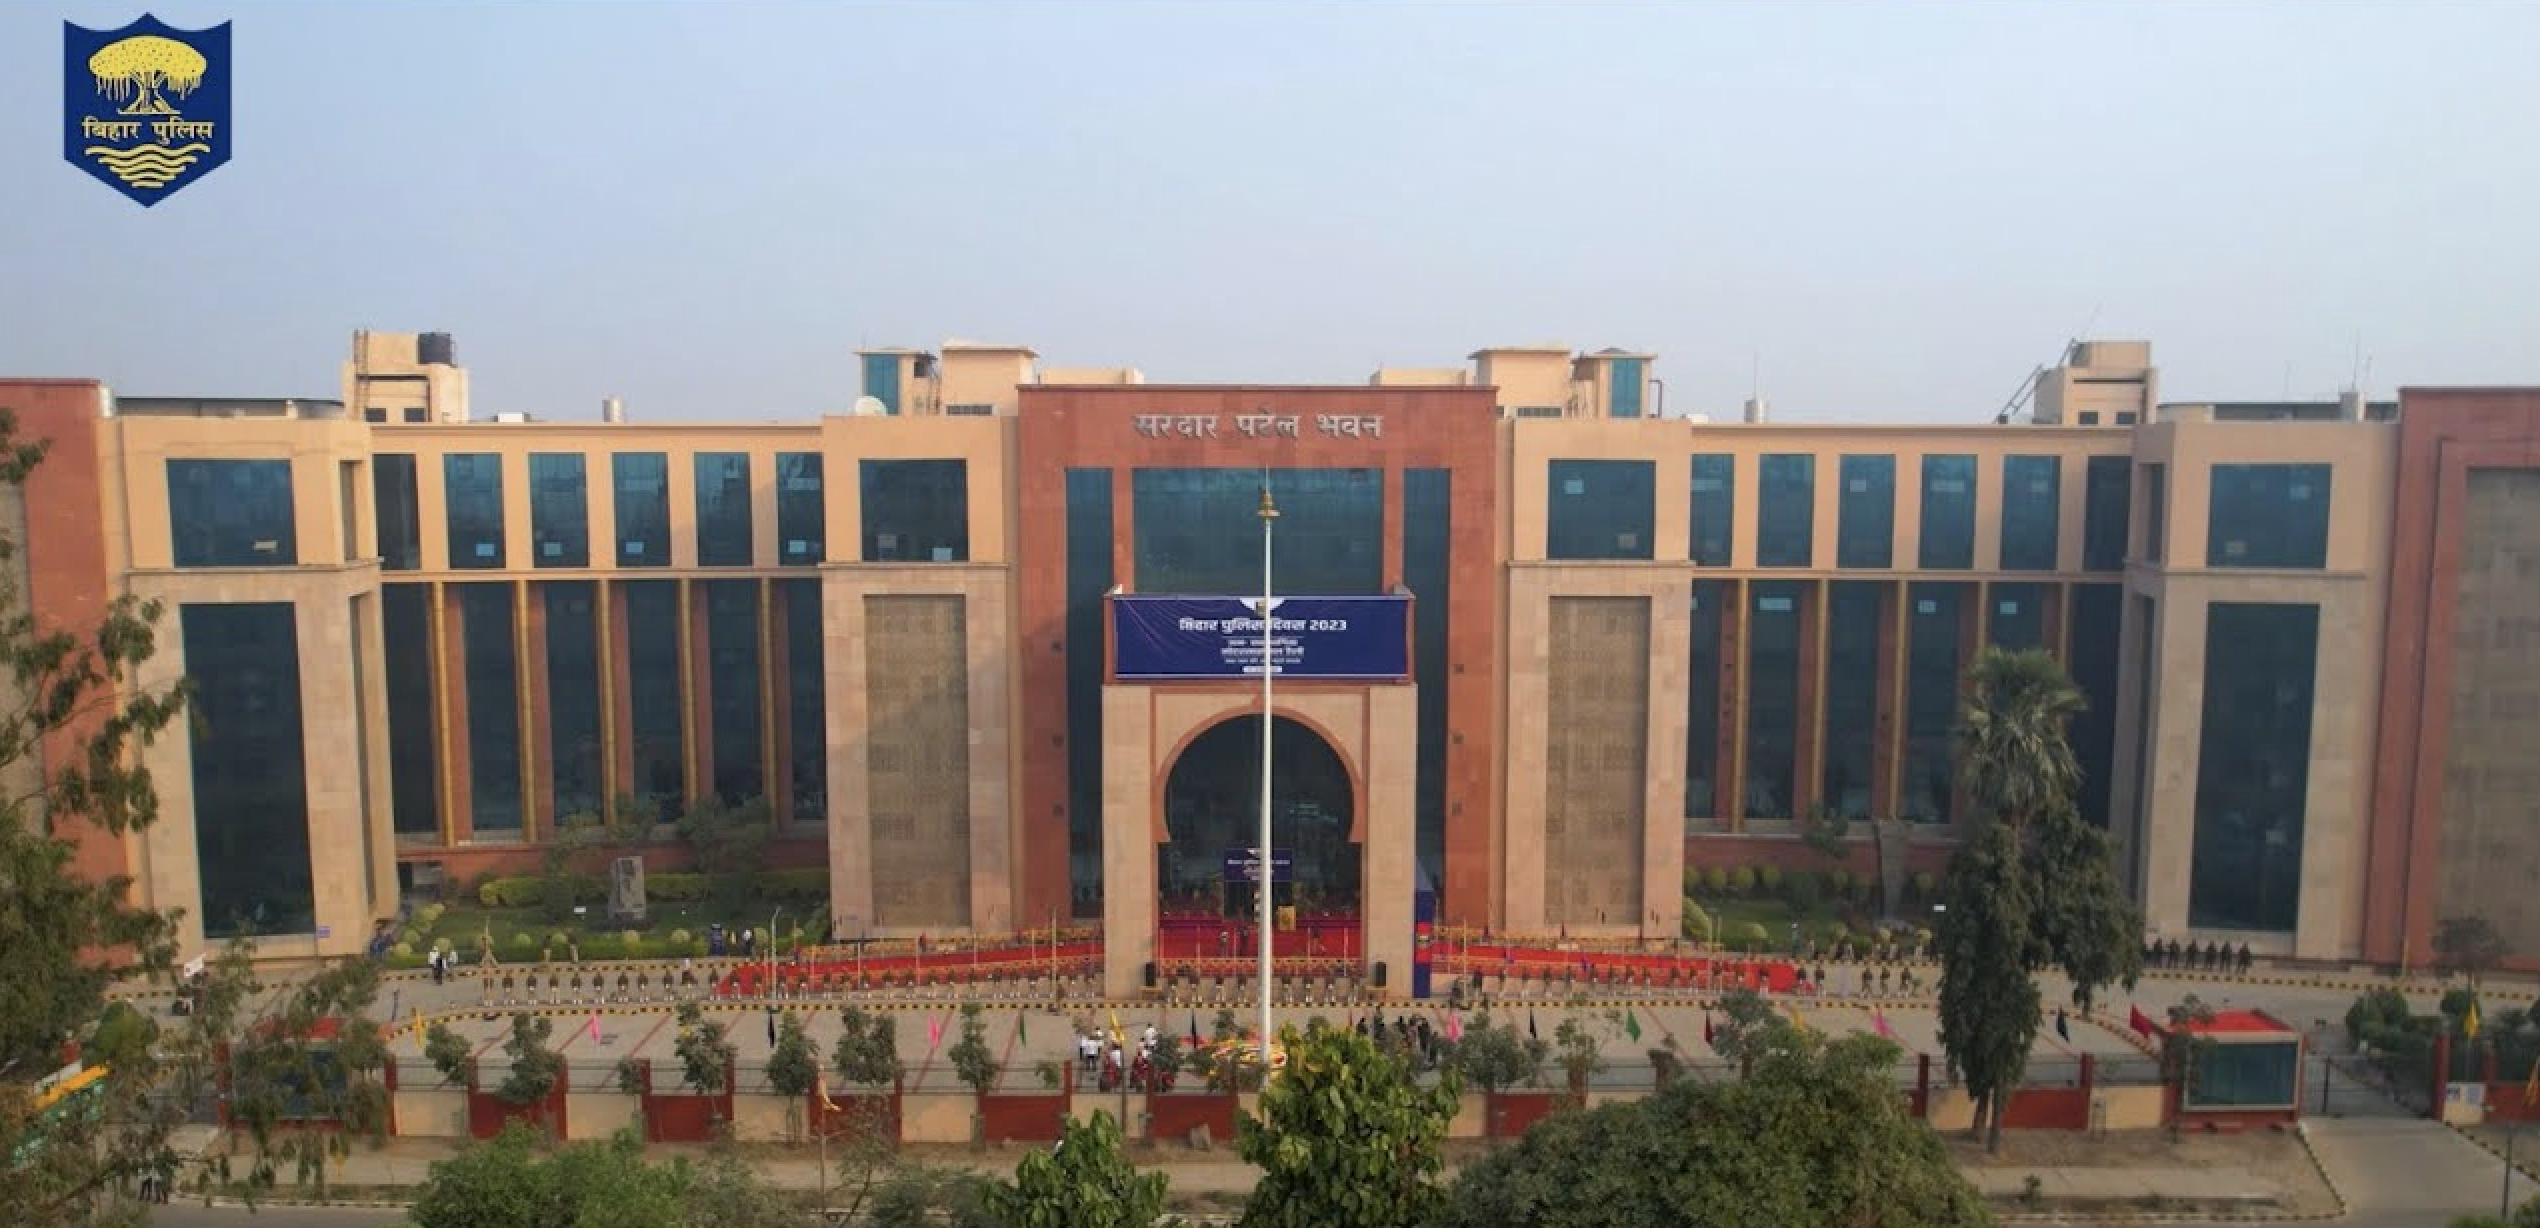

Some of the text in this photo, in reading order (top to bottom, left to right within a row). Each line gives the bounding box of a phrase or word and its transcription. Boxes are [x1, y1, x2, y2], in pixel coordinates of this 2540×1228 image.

[1134, 407, 1384, 440] सरदार पटेल भवन
[1179, 616, 1219, 631] बिहार
[1309, 619, 1347, 631] 2023
